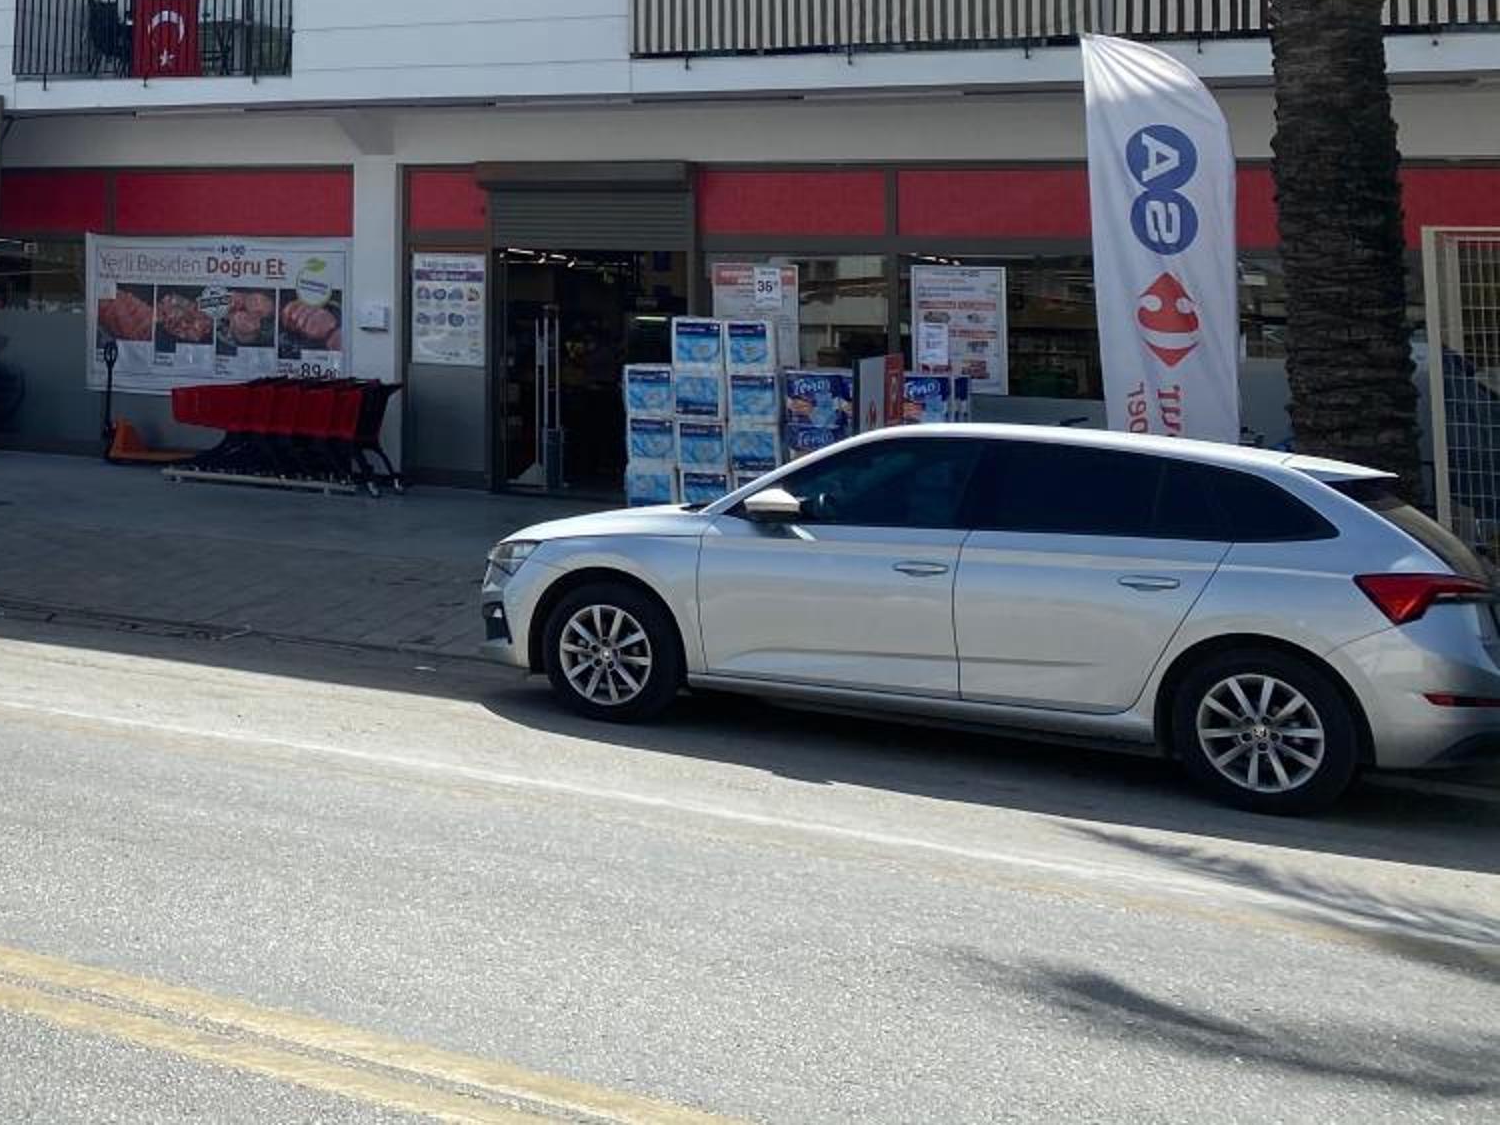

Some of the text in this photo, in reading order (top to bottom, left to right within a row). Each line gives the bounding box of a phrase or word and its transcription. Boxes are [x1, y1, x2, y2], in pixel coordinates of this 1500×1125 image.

[99, 252, 286, 278] Yerli Besiden Doğru Et
